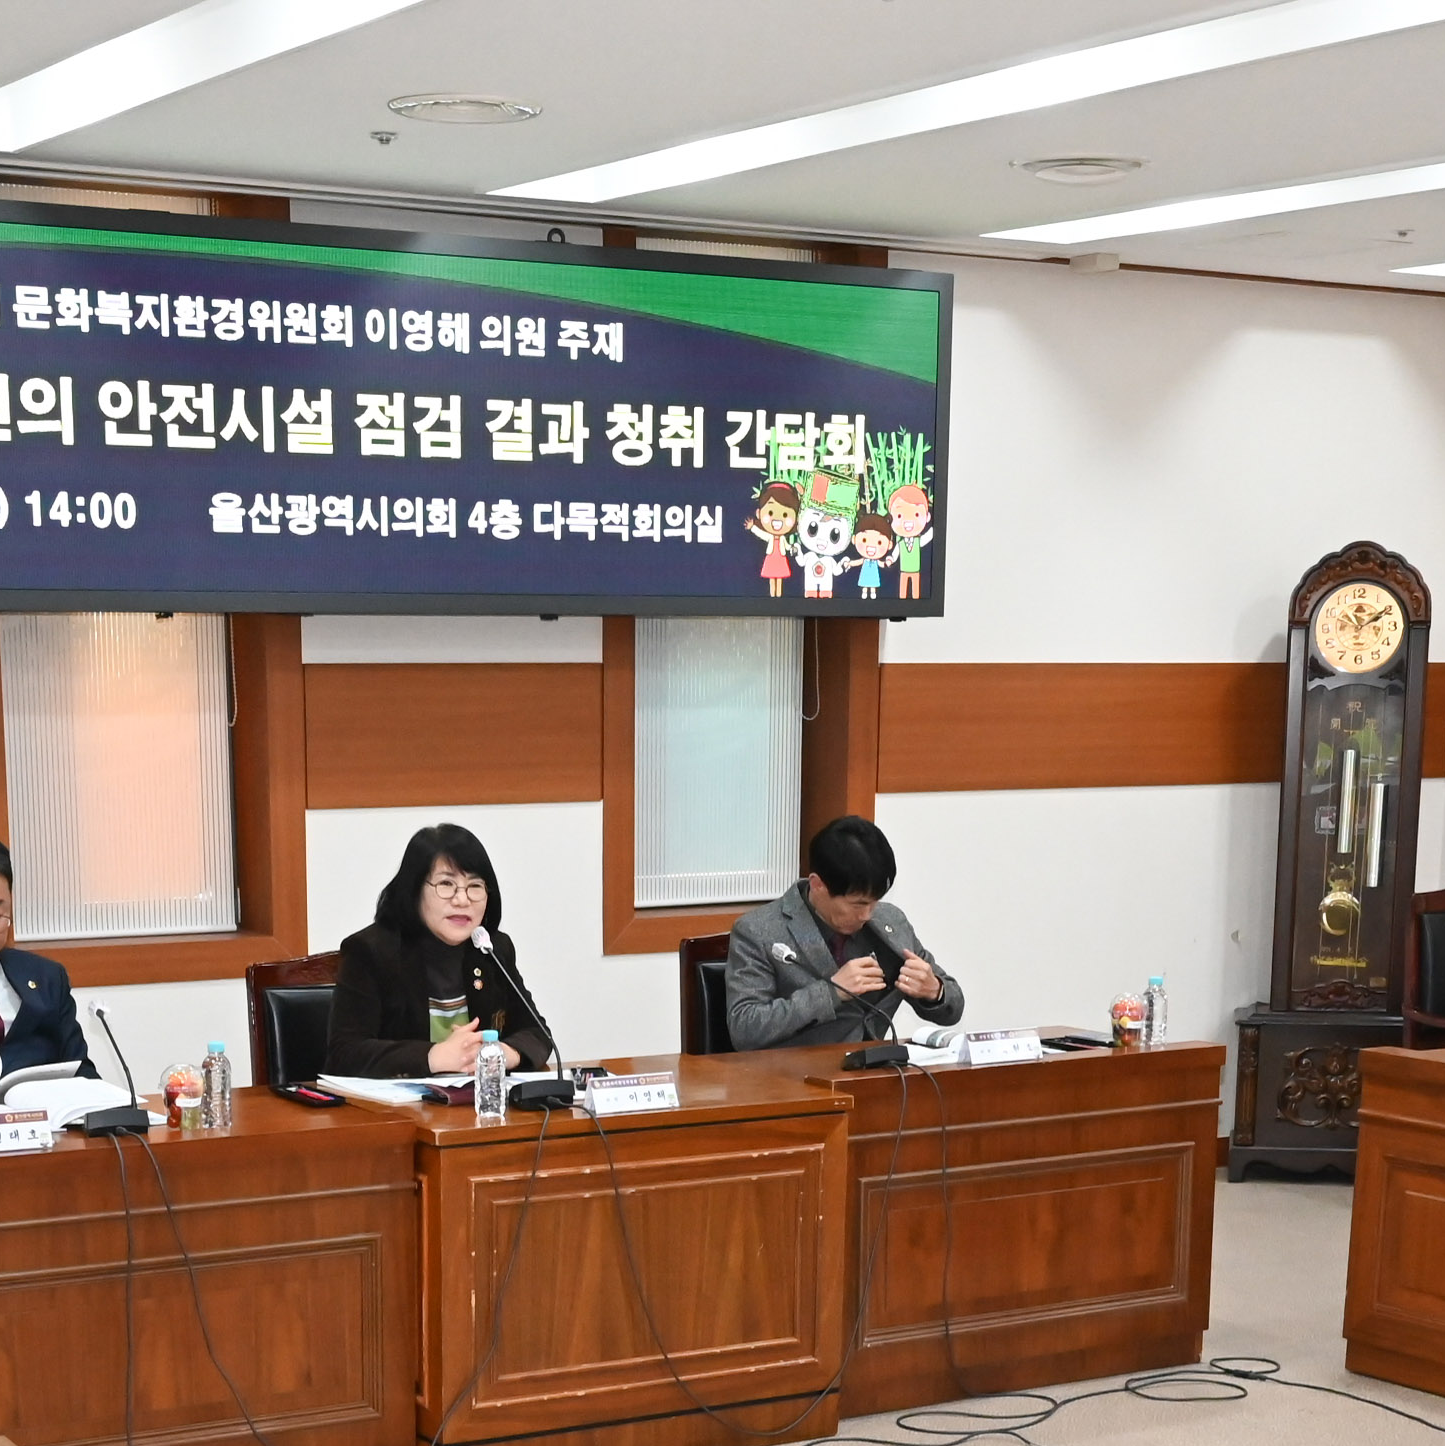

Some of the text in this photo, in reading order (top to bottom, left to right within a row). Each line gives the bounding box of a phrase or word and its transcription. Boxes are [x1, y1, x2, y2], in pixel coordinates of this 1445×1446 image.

[12, 284, 354, 348] 문화복지환경위원회
[365, 310, 470, 354] 이영해
[480, 314, 546, 357] 의원
[557, 319, 625, 363] 주재
[97, 379, 335, 454] 안전시설
[354, 392, 462, 459] 점검
[484, 398, 590, 464] 결과
[605, 404, 705, 468] 청취
[725, 409, 866, 475] 간담회
[24, 490, 138, 530] 14:00
[208, 491, 456, 538] 울산광역시의회
[468, 499, 523, 540] 4층
[534, 500, 723, 543] 다목적회의실
